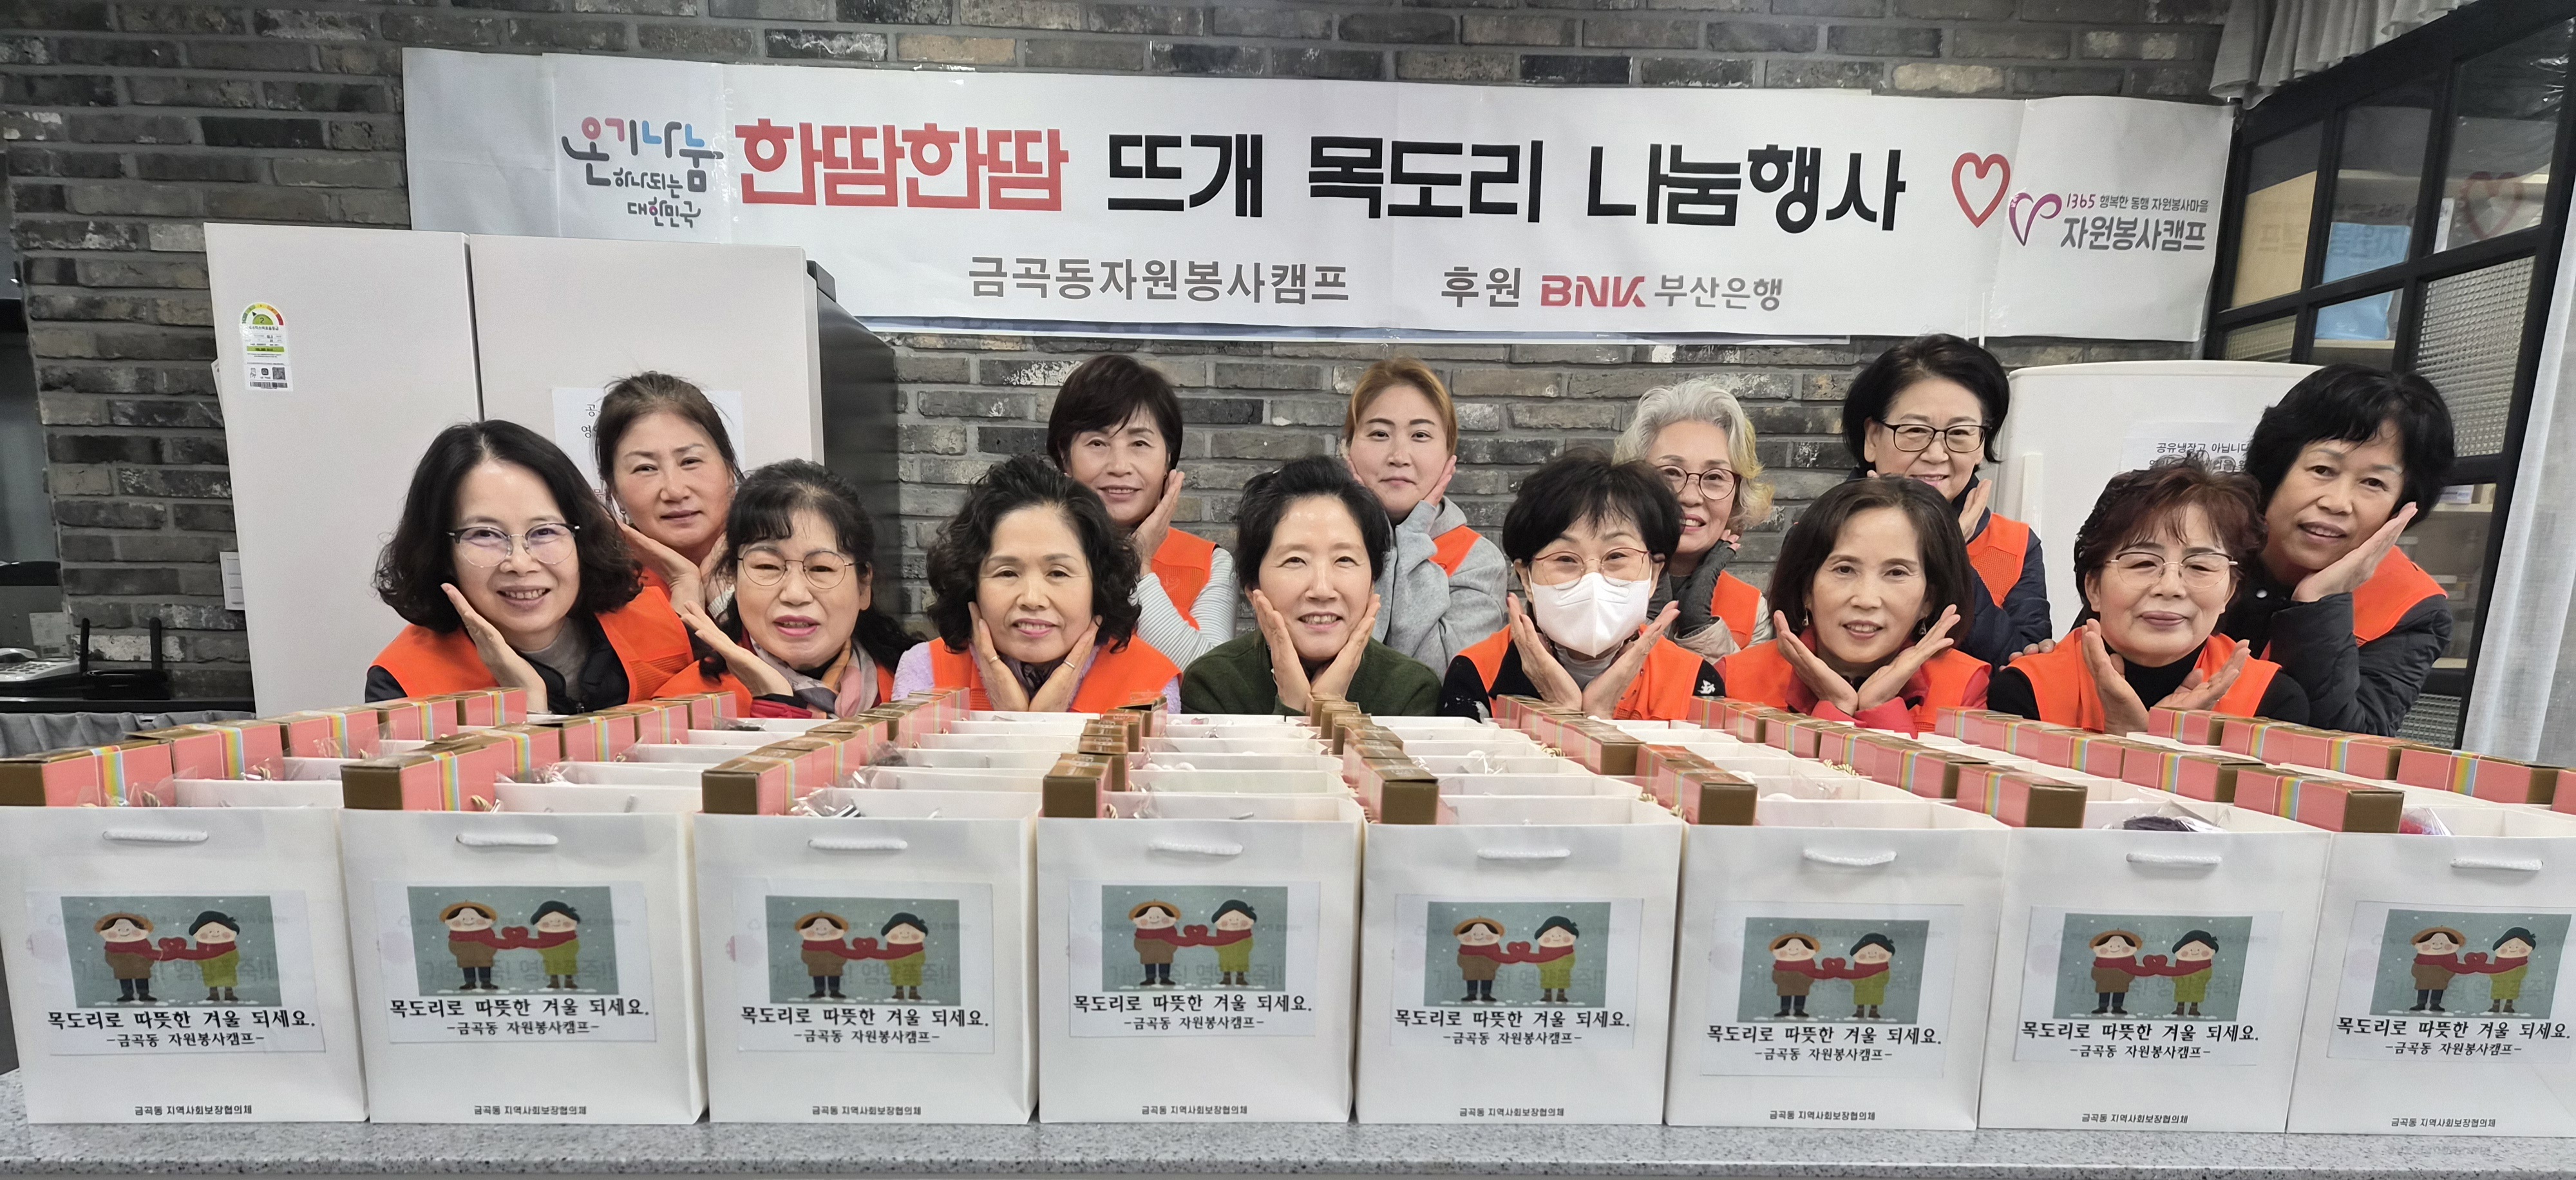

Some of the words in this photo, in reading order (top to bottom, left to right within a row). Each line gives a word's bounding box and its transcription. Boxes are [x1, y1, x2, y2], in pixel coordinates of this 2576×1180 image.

[561, 116, 724, 193] 온기나눔
[612, 167, 683, 199] 하나되는
[735, 119, 1069, 211] 한땀한땀
[1108, 134, 1262, 217] 뜨개
[1309, 137, 1543, 223] 목도리
[1587, 144, 1906, 233] 나눔행사
[627, 196, 701, 229] 대한민국
[2066, 193, 2096, 209] 1365
[2100, 195, 2128, 209] 행복한
[2132, 197, 2149, 210] 동행
[2152, 198, 2208, 213] 자원봉사마을
[2060, 216, 2206, 252] 자원봉사캠프
[969, 257, 1349, 305] 금곡동자원봉사캠프
[1442, 267, 1520, 307] 후원
[1541, 276, 1645, 307] BNK
[1654, 275, 1782, 311] 부산은행
[390, 999, 464, 1018] 목도리로
[475, 998, 531, 1017] 따뜻한
[542, 998, 578, 1016] 겨울
[589, 998, 649, 1016] 되세요.
[1073, 995, 1142, 1013] 목도리로
[1152, 994, 1203, 1013] 따뜻한
[1213, 994, 1246, 1012] 겨울
[1256, 994, 1312, 1013] 되세요.
[48, 1011, 124, 1030] 목도리로
[133, 1011, 191, 1029] 따뜻한
[203, 1010, 240, 1028] 겨울
[251, 1009, 315, 1028] 되세요.
[741, 1006, 811, 1025] 목도리로
[822, 1007, 875, 1025] 따뜻한
[887, 1009, 920, 1026] 겨울
[931, 1009, 989, 1027] 되세요.
[1394, 1009, 1462, 1027] 목도리로
[1472, 1011, 1523, 1028] 따뜻한
[1533, 1011, 1566, 1028] 겨울
[1575, 1011, 1630, 1028] 되세요.
[1707, 1025, 1774, 1043] 목도리로
[1785, 1026, 1834, 1043] 따뜻한
[1844, 1027, 1877, 1044] 겨울
[1886, 1027, 1941, 1045] 되세요.
[2021, 1021, 2090, 1040] 목도리로
[2101, 1023, 2152, 1041] 따뜻한
[2163, 1024, 2196, 1042] 겨울
[2206, 1024, 2259, 1042] 되세요.
[2336, 1017, 2407, 1037] 목도리로
[2418, 1020, 2469, 1038] 따뜻한
[2477, 1022, 2510, 1039] 겨울
[2519, 1022, 2570, 1040] 되세요.
[135, 1106, 163, 1116] 금곡동
[166, 1105, 252, 1115] 지역사회보장협의체
[473, 1105, 501, 1116] 금곡동
[504, 1105, 587, 1116] 지역사회보장협의체
[811, 1106, 838, 1116] 금곡동
[841, 1106, 922, 1116] 지역사회보장협의체
[1141, 1105, 1167, 1115] 금곡동
[1170, 1105, 1247, 1115] 지역사회보장협의체
[1459, 1108, 1484, 1117] 금곡동
[1488, 1108, 1564, 1117] 지역사회보장협의체
[1769, 1110, 1795, 1120] 금곡동
[1797, 1110, 1875, 1121] 지역사회보장협의체
[2081, 1113, 2107, 1123] 금곡동
[2110, 1114, 2188, 1124] 지역사회보장협의체
[2391, 1118, 2417, 1127] 금곡동
[2420, 1118, 2496, 1128] 지역사회보장협의체
